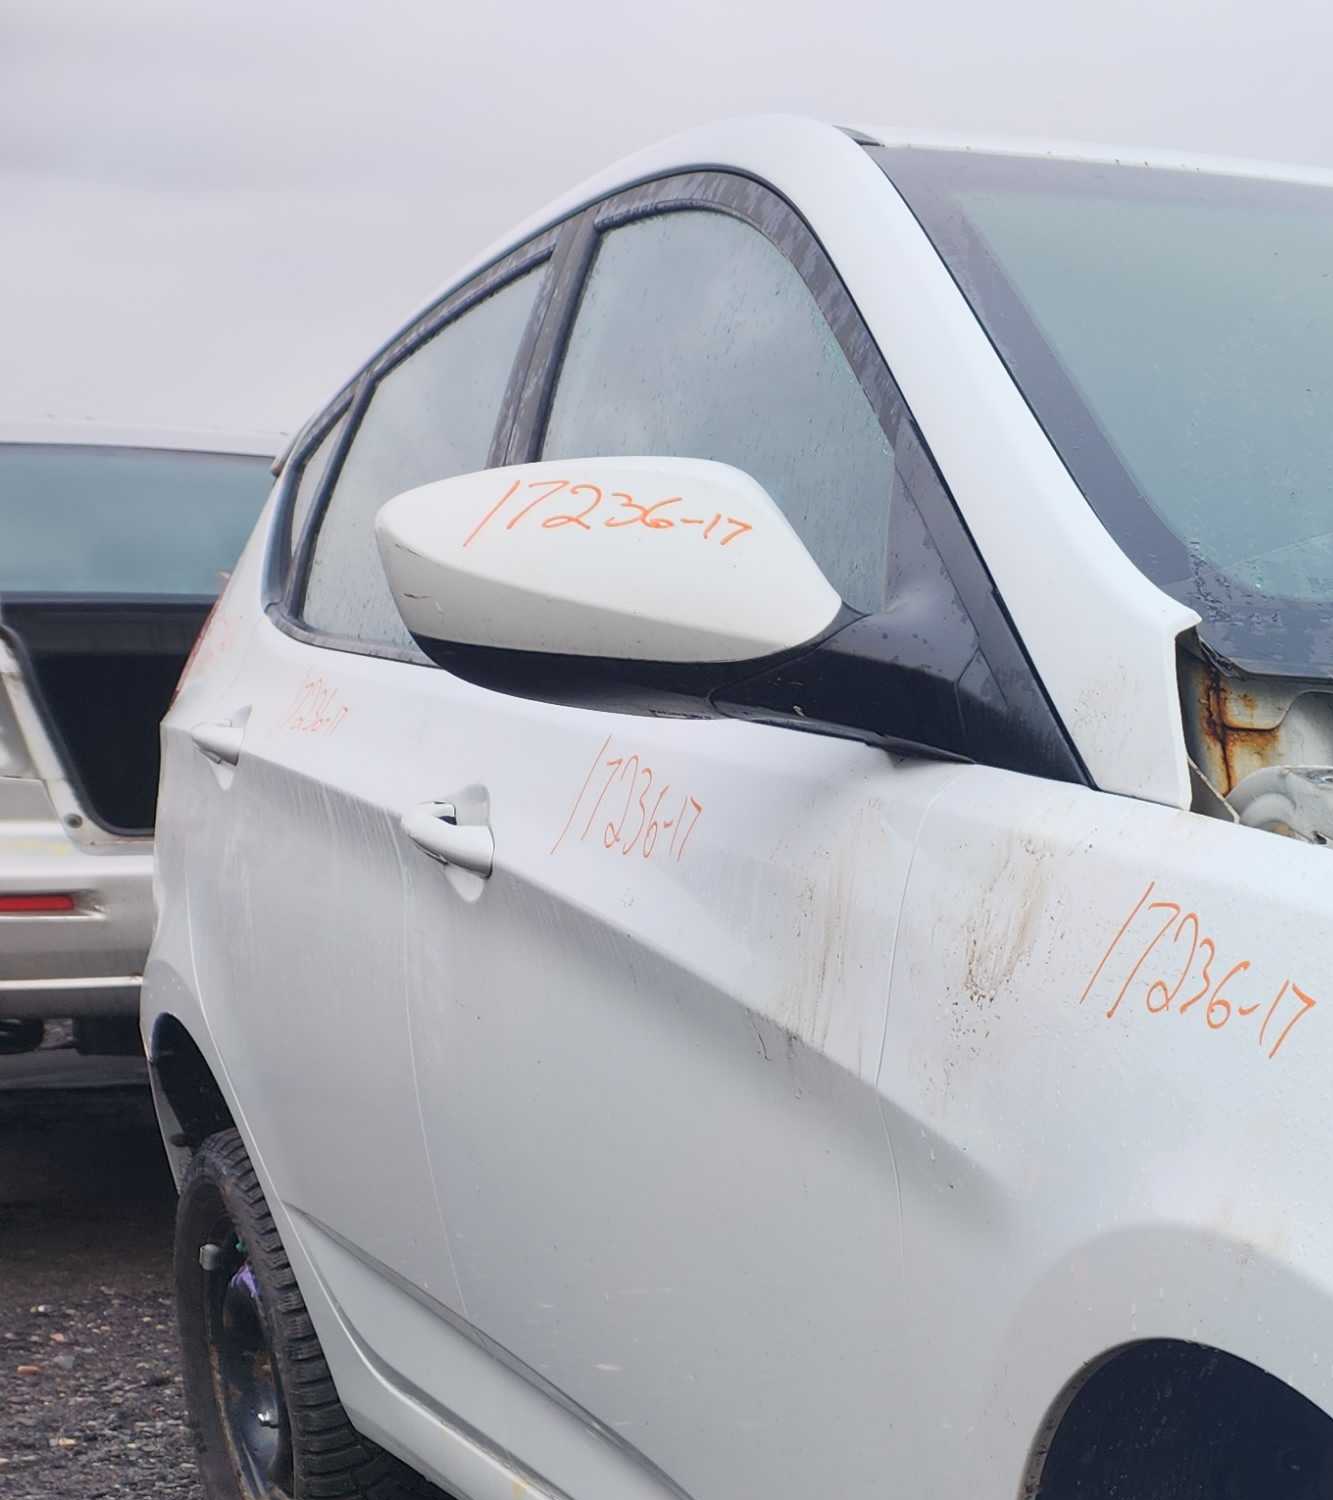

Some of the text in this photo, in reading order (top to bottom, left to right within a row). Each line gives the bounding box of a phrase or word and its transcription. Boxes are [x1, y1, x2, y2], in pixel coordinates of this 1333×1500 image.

[463, 480, 753, 547] 17236-17
[550, 734, 703, 862] 17236-17
[1079, 880, 1317, 1058] 17236-17
